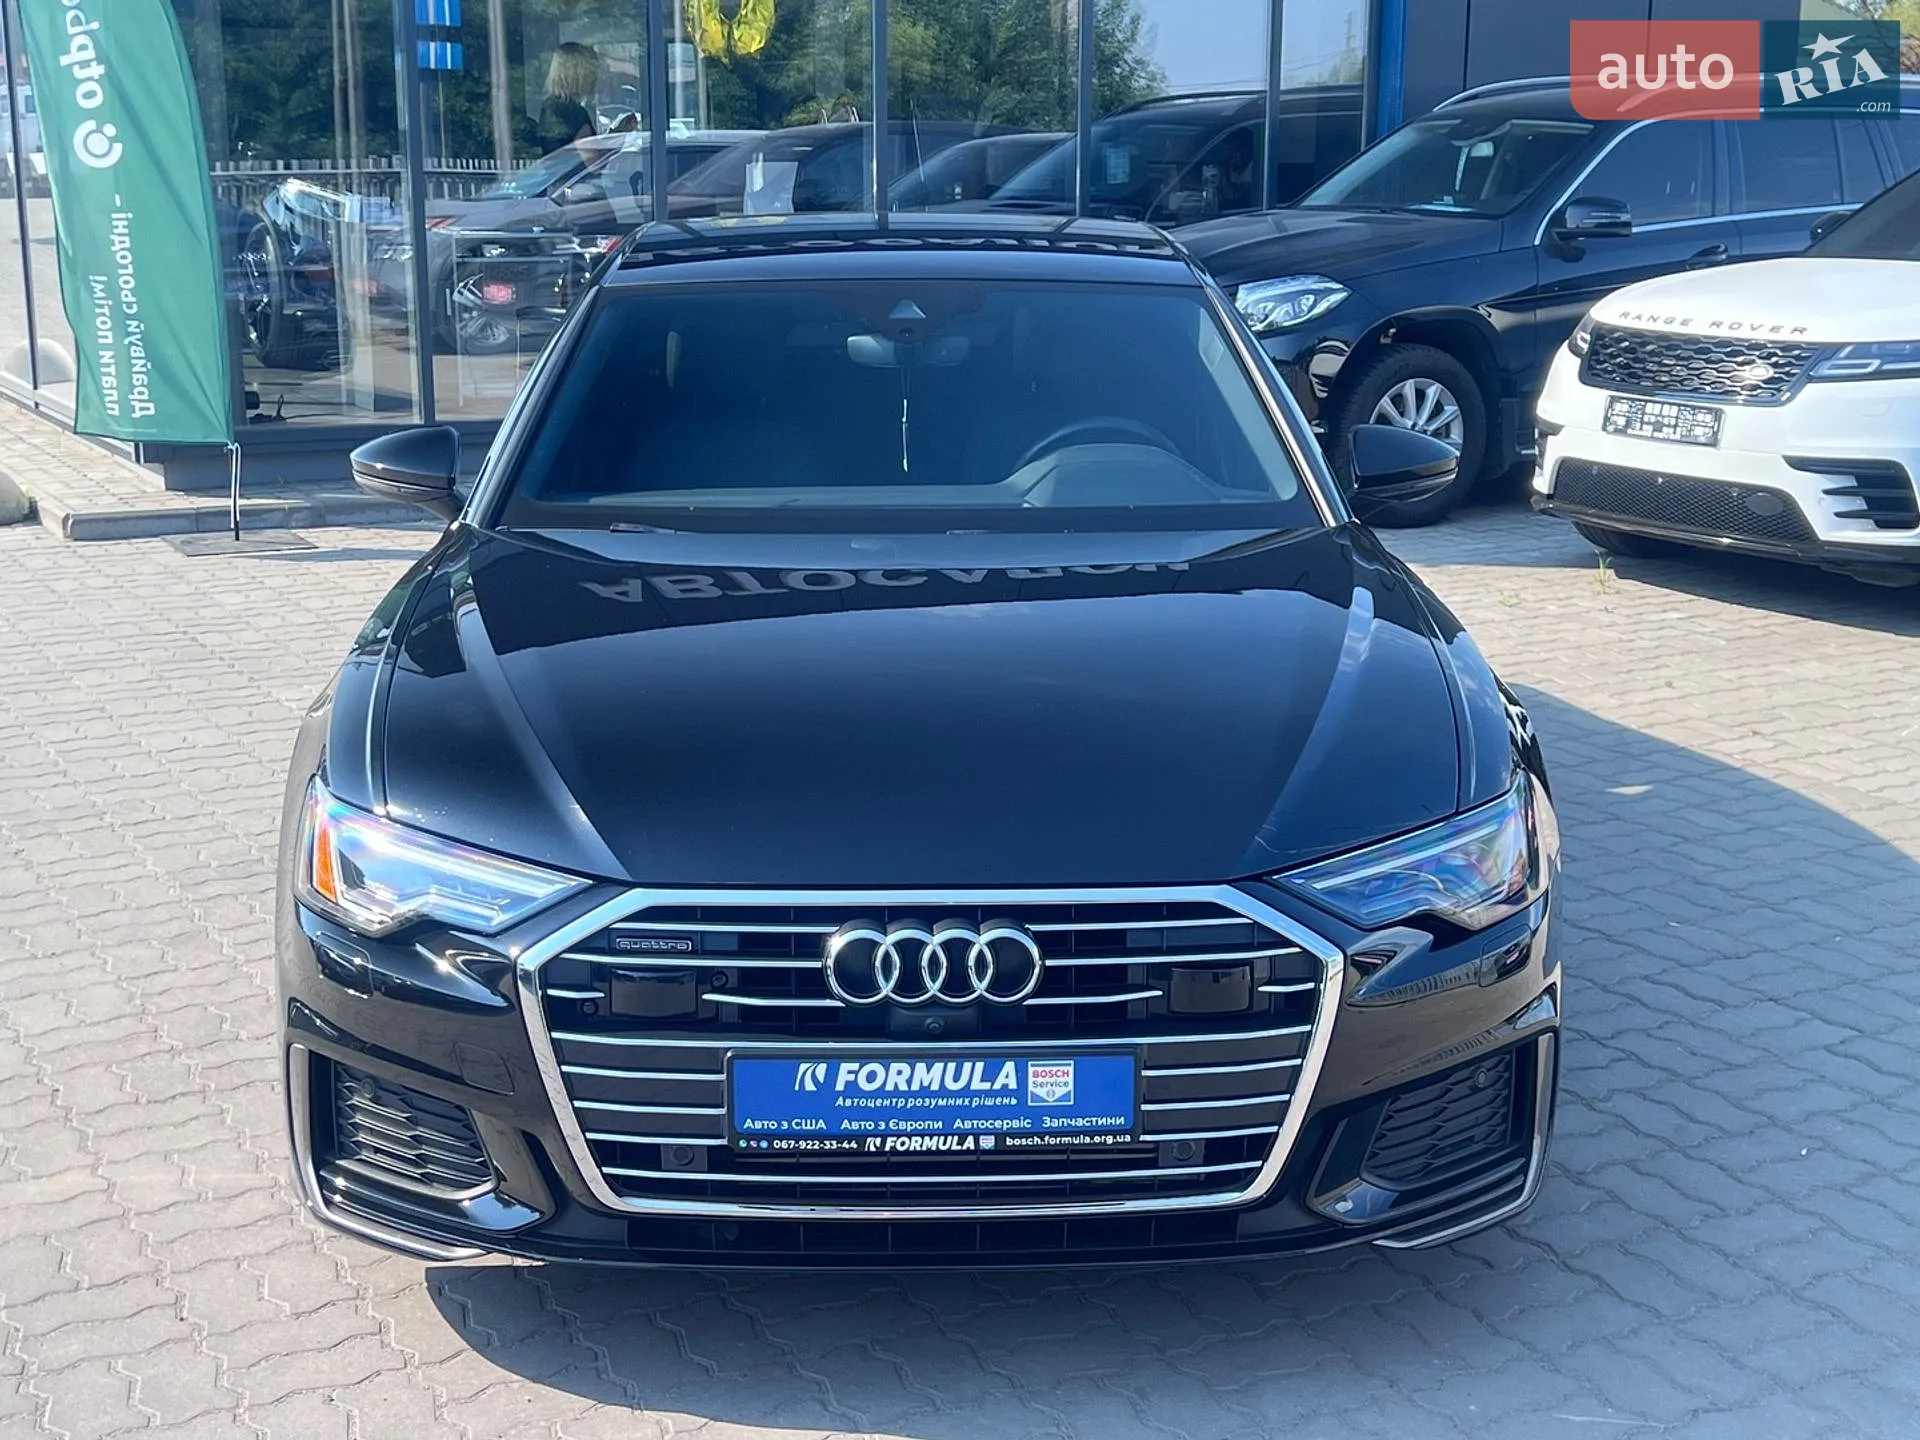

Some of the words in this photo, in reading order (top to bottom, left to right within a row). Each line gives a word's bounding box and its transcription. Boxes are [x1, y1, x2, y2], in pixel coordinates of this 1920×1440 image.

[1618, 311, 1694, 328] RANGE
[1708, 320, 1809, 336] ROVER
[619, 941, 688, 950] quattro
[834, 1060, 1018, 1092] FORMULA
[1032, 1069, 1070, 1079] BOSCH
[1032, 1080, 1070, 1089] Service
[834, 1096, 905, 1109] Автоцентр
[906, 1096, 970, 1109] розумних
[971, 1094, 1018, 1108] рішень
[743, 1118, 778, 1130] Авто
[781, 1121, 788, 1130] з
[791, 1118, 827, 1130] США
[840, 1118, 875, 1130] Авто
[877, 1121, 885, 1130] з
[889, 1117, 943, 1132] Європи
[953, 1116, 1032, 1131] Автосервіс
[1042, 1116, 1125, 1128] Запчастини
[773, 1139, 858, 1149] 067-922-33-44
[884, 1135, 975, 1151] FORMULA
[1005, 1134, 1131, 1147] bosch.formula.org.ua
